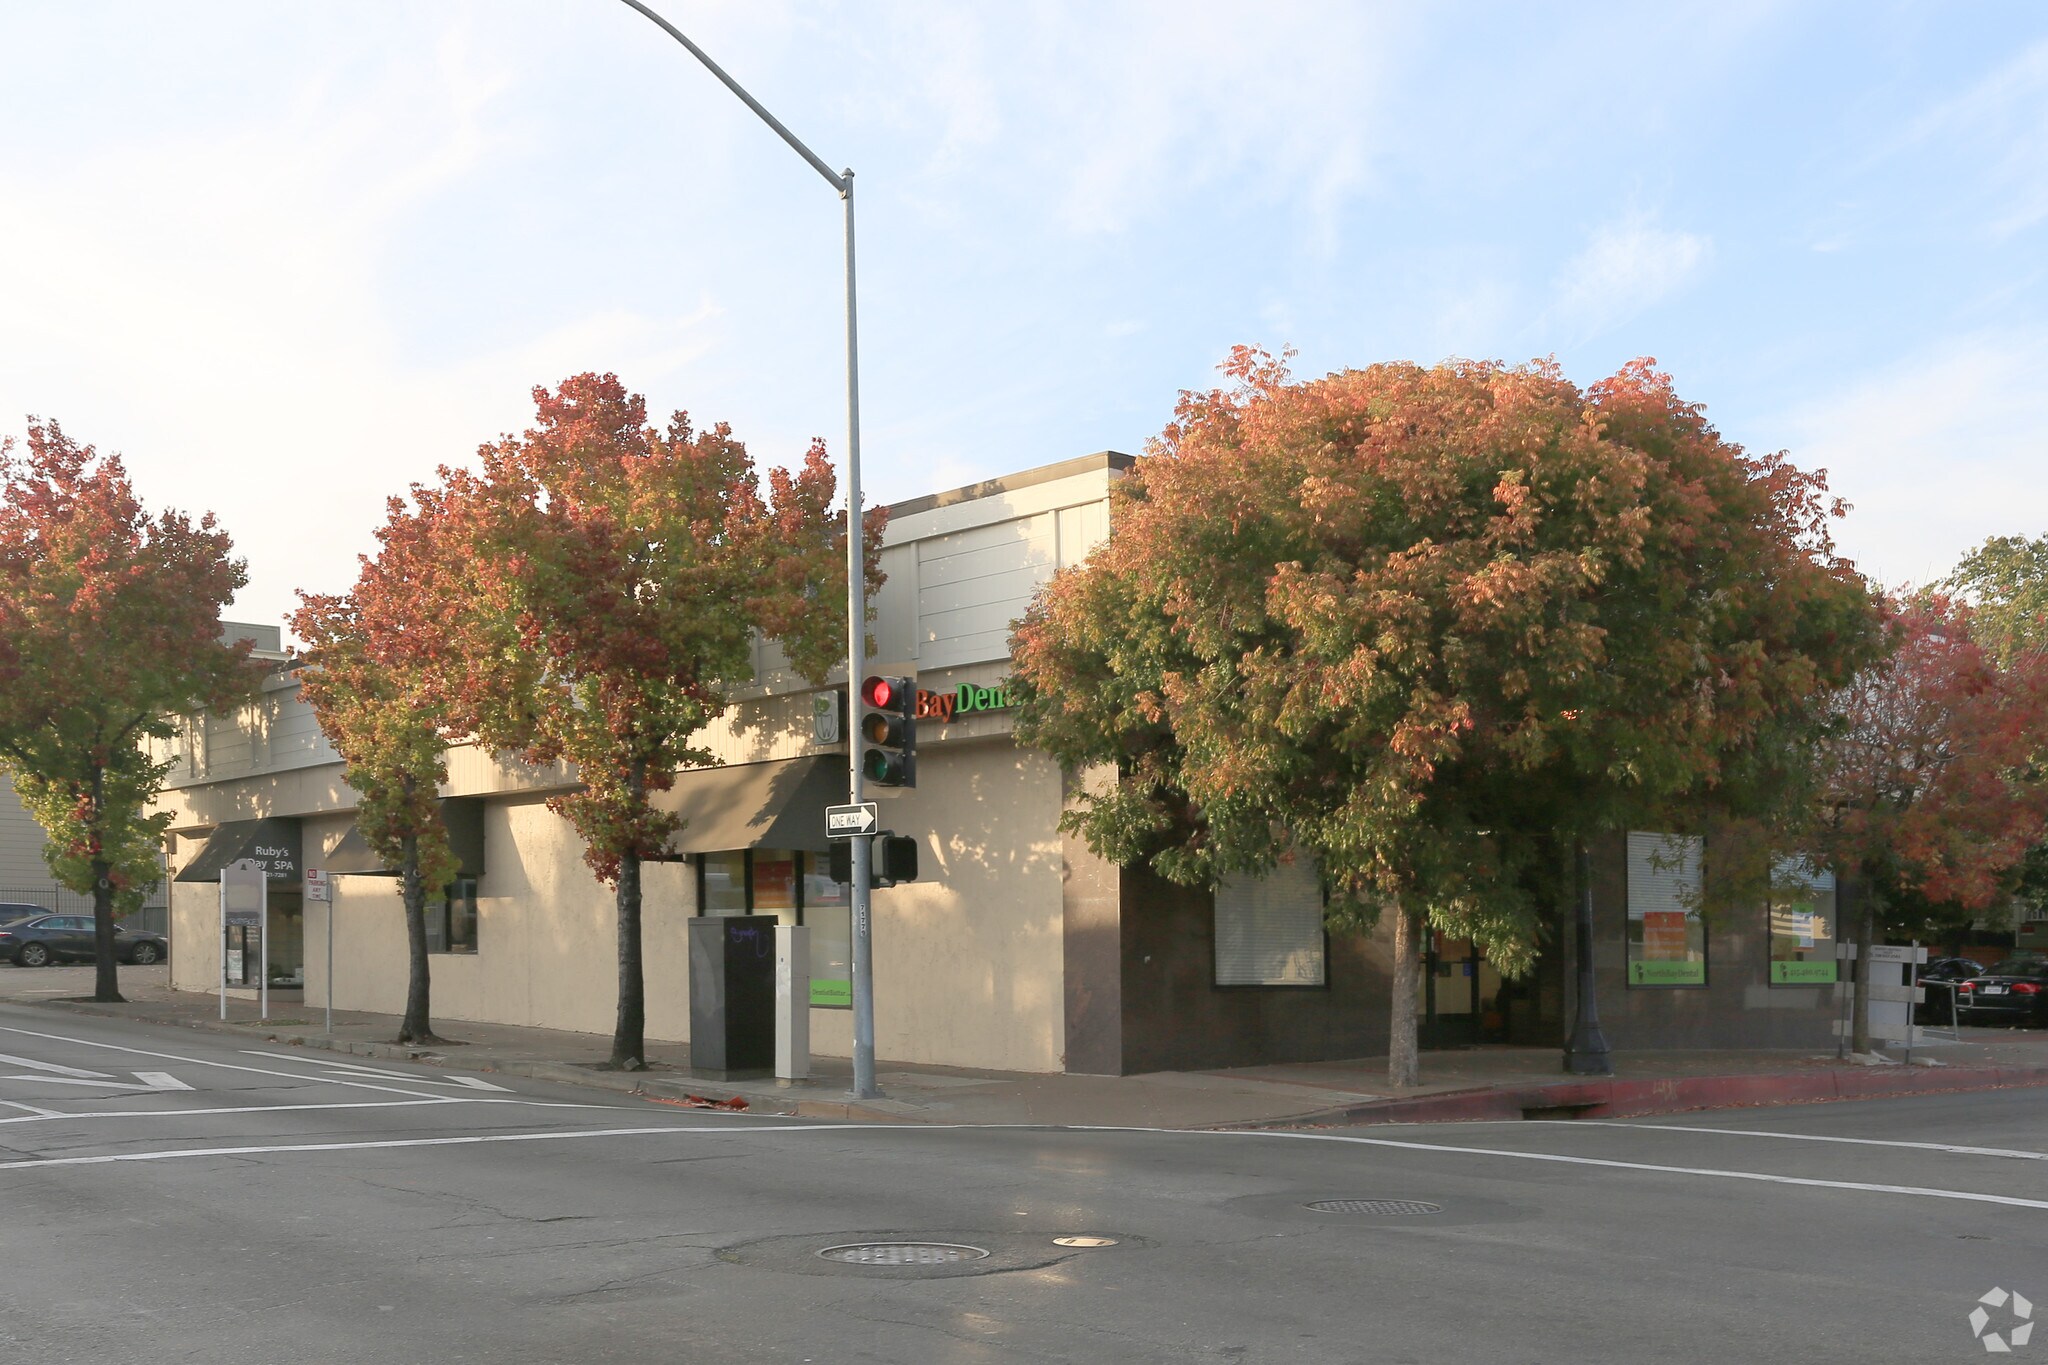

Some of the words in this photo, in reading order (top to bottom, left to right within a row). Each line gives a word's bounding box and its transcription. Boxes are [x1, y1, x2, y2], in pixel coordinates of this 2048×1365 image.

[832, 815, 844, 827] ONE
[846, 814, 860, 826] WAY
[255, 846, 289, 858] Ruby's
[274, 860, 294, 870] SPA
